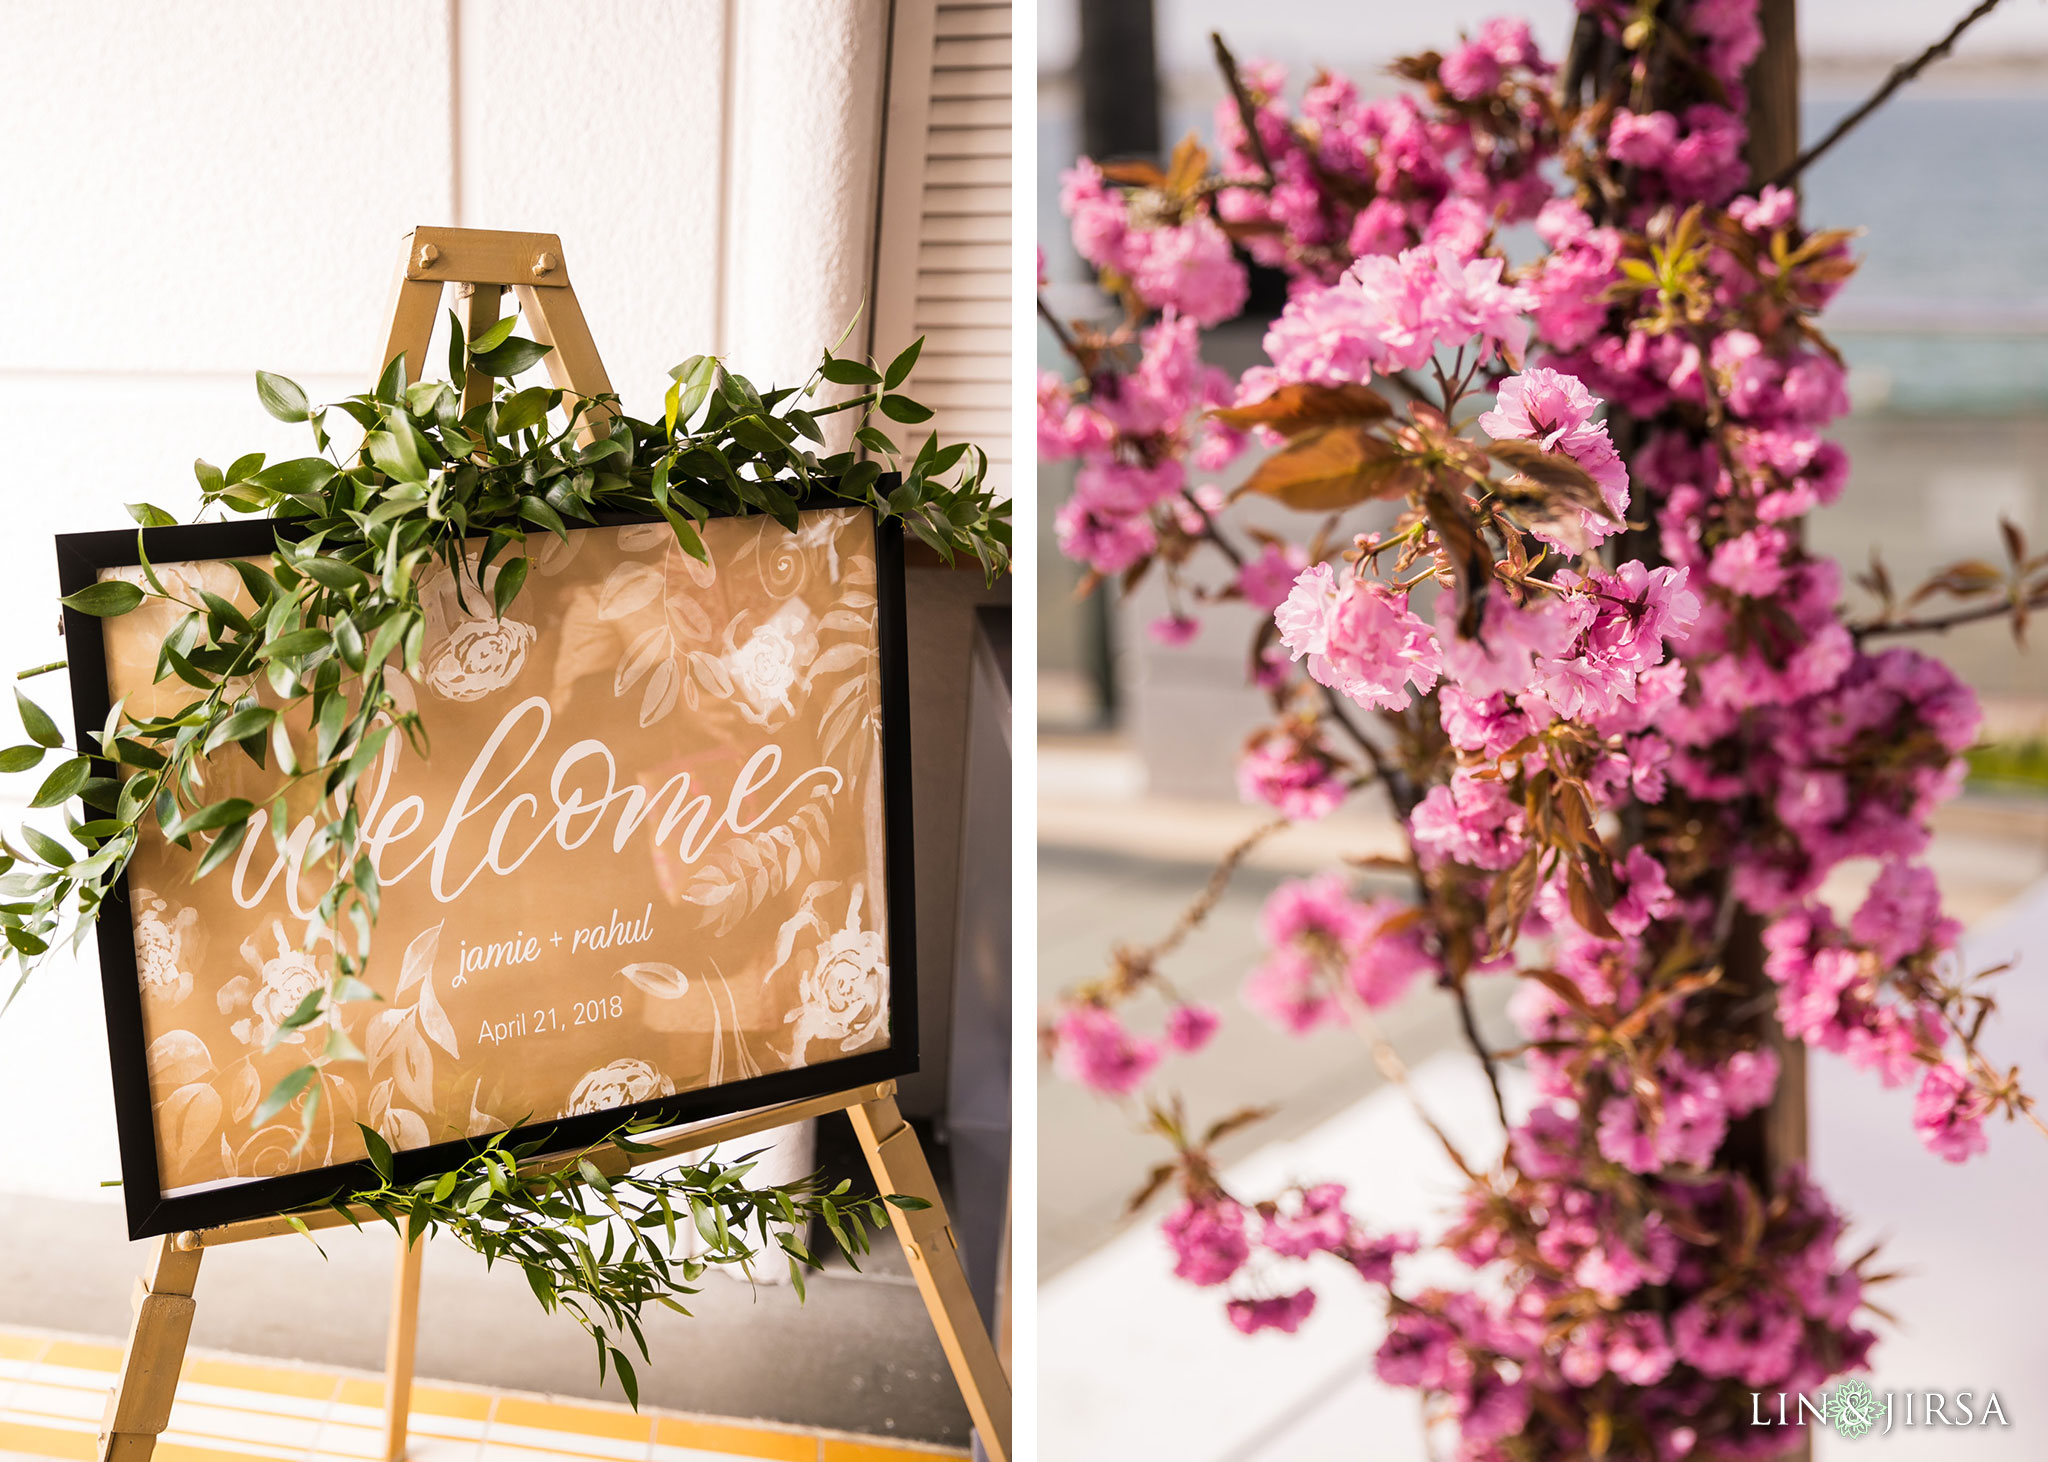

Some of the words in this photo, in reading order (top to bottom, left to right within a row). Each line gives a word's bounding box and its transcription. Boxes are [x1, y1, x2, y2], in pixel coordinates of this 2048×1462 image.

[451, 930, 542, 988] jamie
[549, 931, 563, 947] +
[571, 902, 654, 955] rahul
[478, 1013, 526, 1046] April
[533, 1007, 566, 1033] 21,
[573, 995, 623, 1026] 2018
